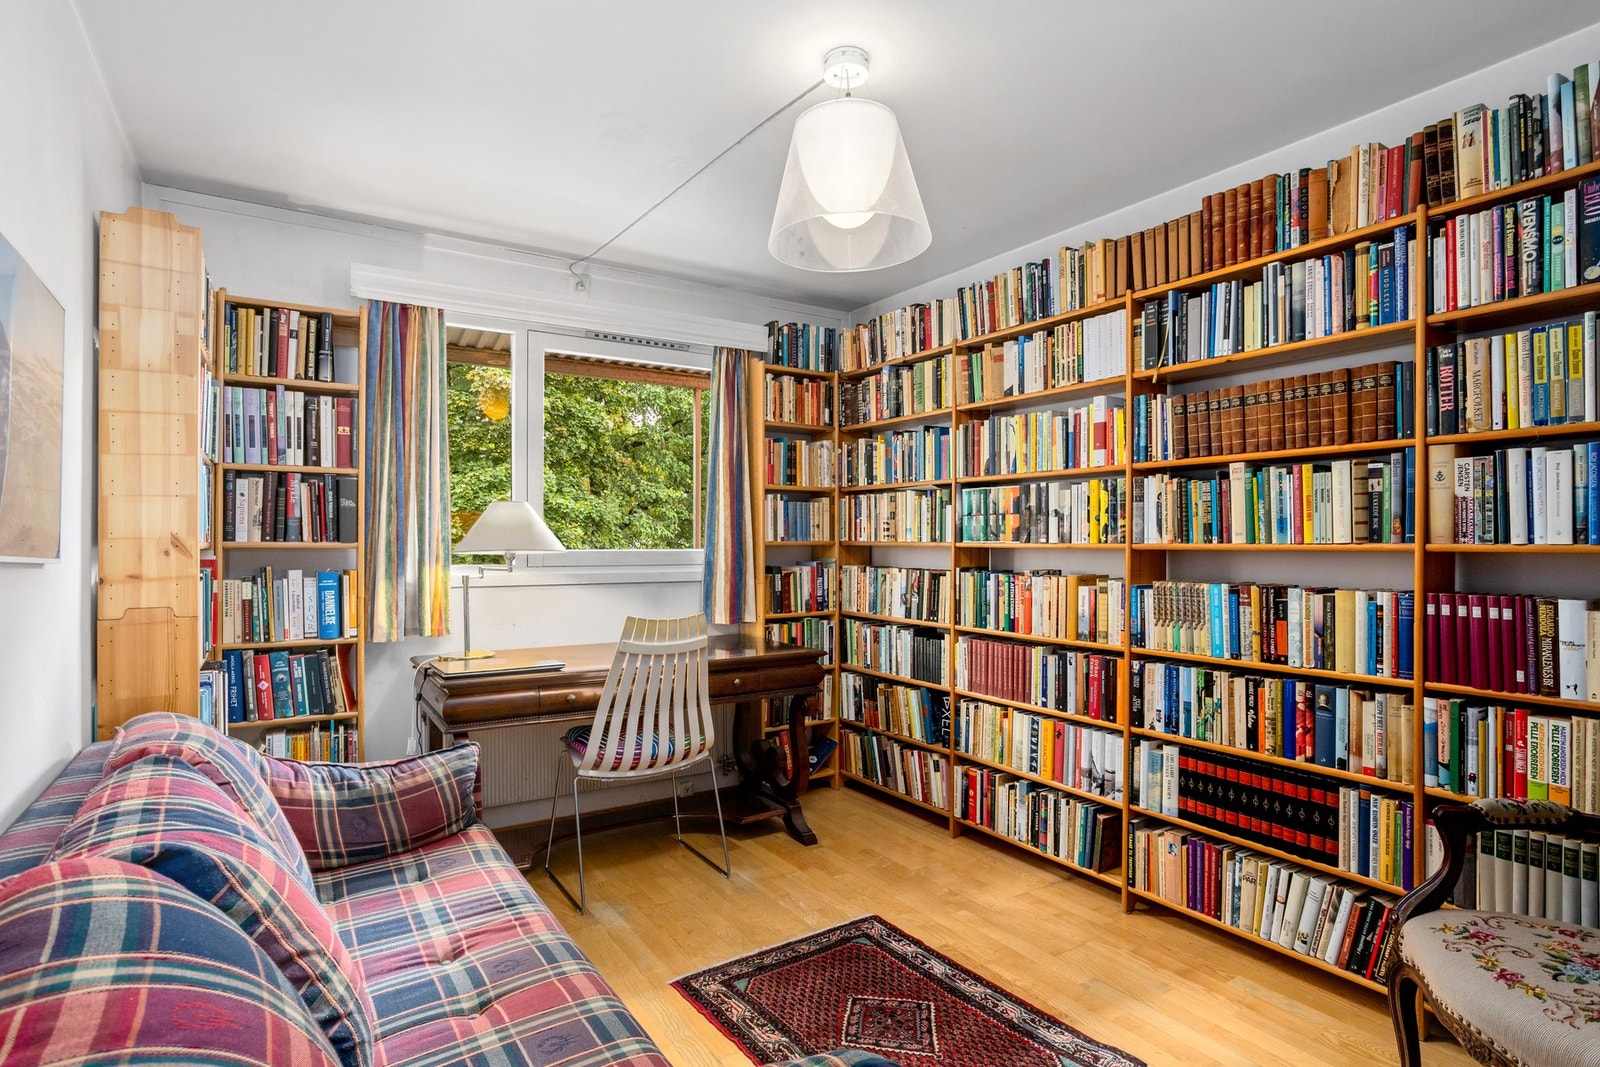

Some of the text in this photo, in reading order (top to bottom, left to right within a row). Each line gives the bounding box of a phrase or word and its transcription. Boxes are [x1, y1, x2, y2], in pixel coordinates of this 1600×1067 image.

[1506, 207, 1515, 228] Sigurd
[1523, 200, 1538, 262] EVENSMO
[1506, 229, 1515, 256] Evensmo
[1520, 353, 1529, 373] Hauge
[1440, 365, 1454, 412] ROTTER
[1472, 370, 1483, 423] MARGFOLKET
[1521, 374, 1529, 407] Mysterium
[288, 479, 299, 503] Mykle
[238, 498, 248, 525] Sapiens
[325, 590, 336, 625] DANNELSE
[1539, 605, 1548, 636] MENDOZA
[1546, 605, 1555, 637] EDUARDO
[1542, 638, 1554, 688] MIRAKLENES BY
[230, 686, 238, 708] FRIHET
[1376, 699, 1384, 716] JOSEPH
[1530, 721, 1538, 780] PELLE EROBREREN
[1551, 724, 1560, 784] PELLE EROBREREN
